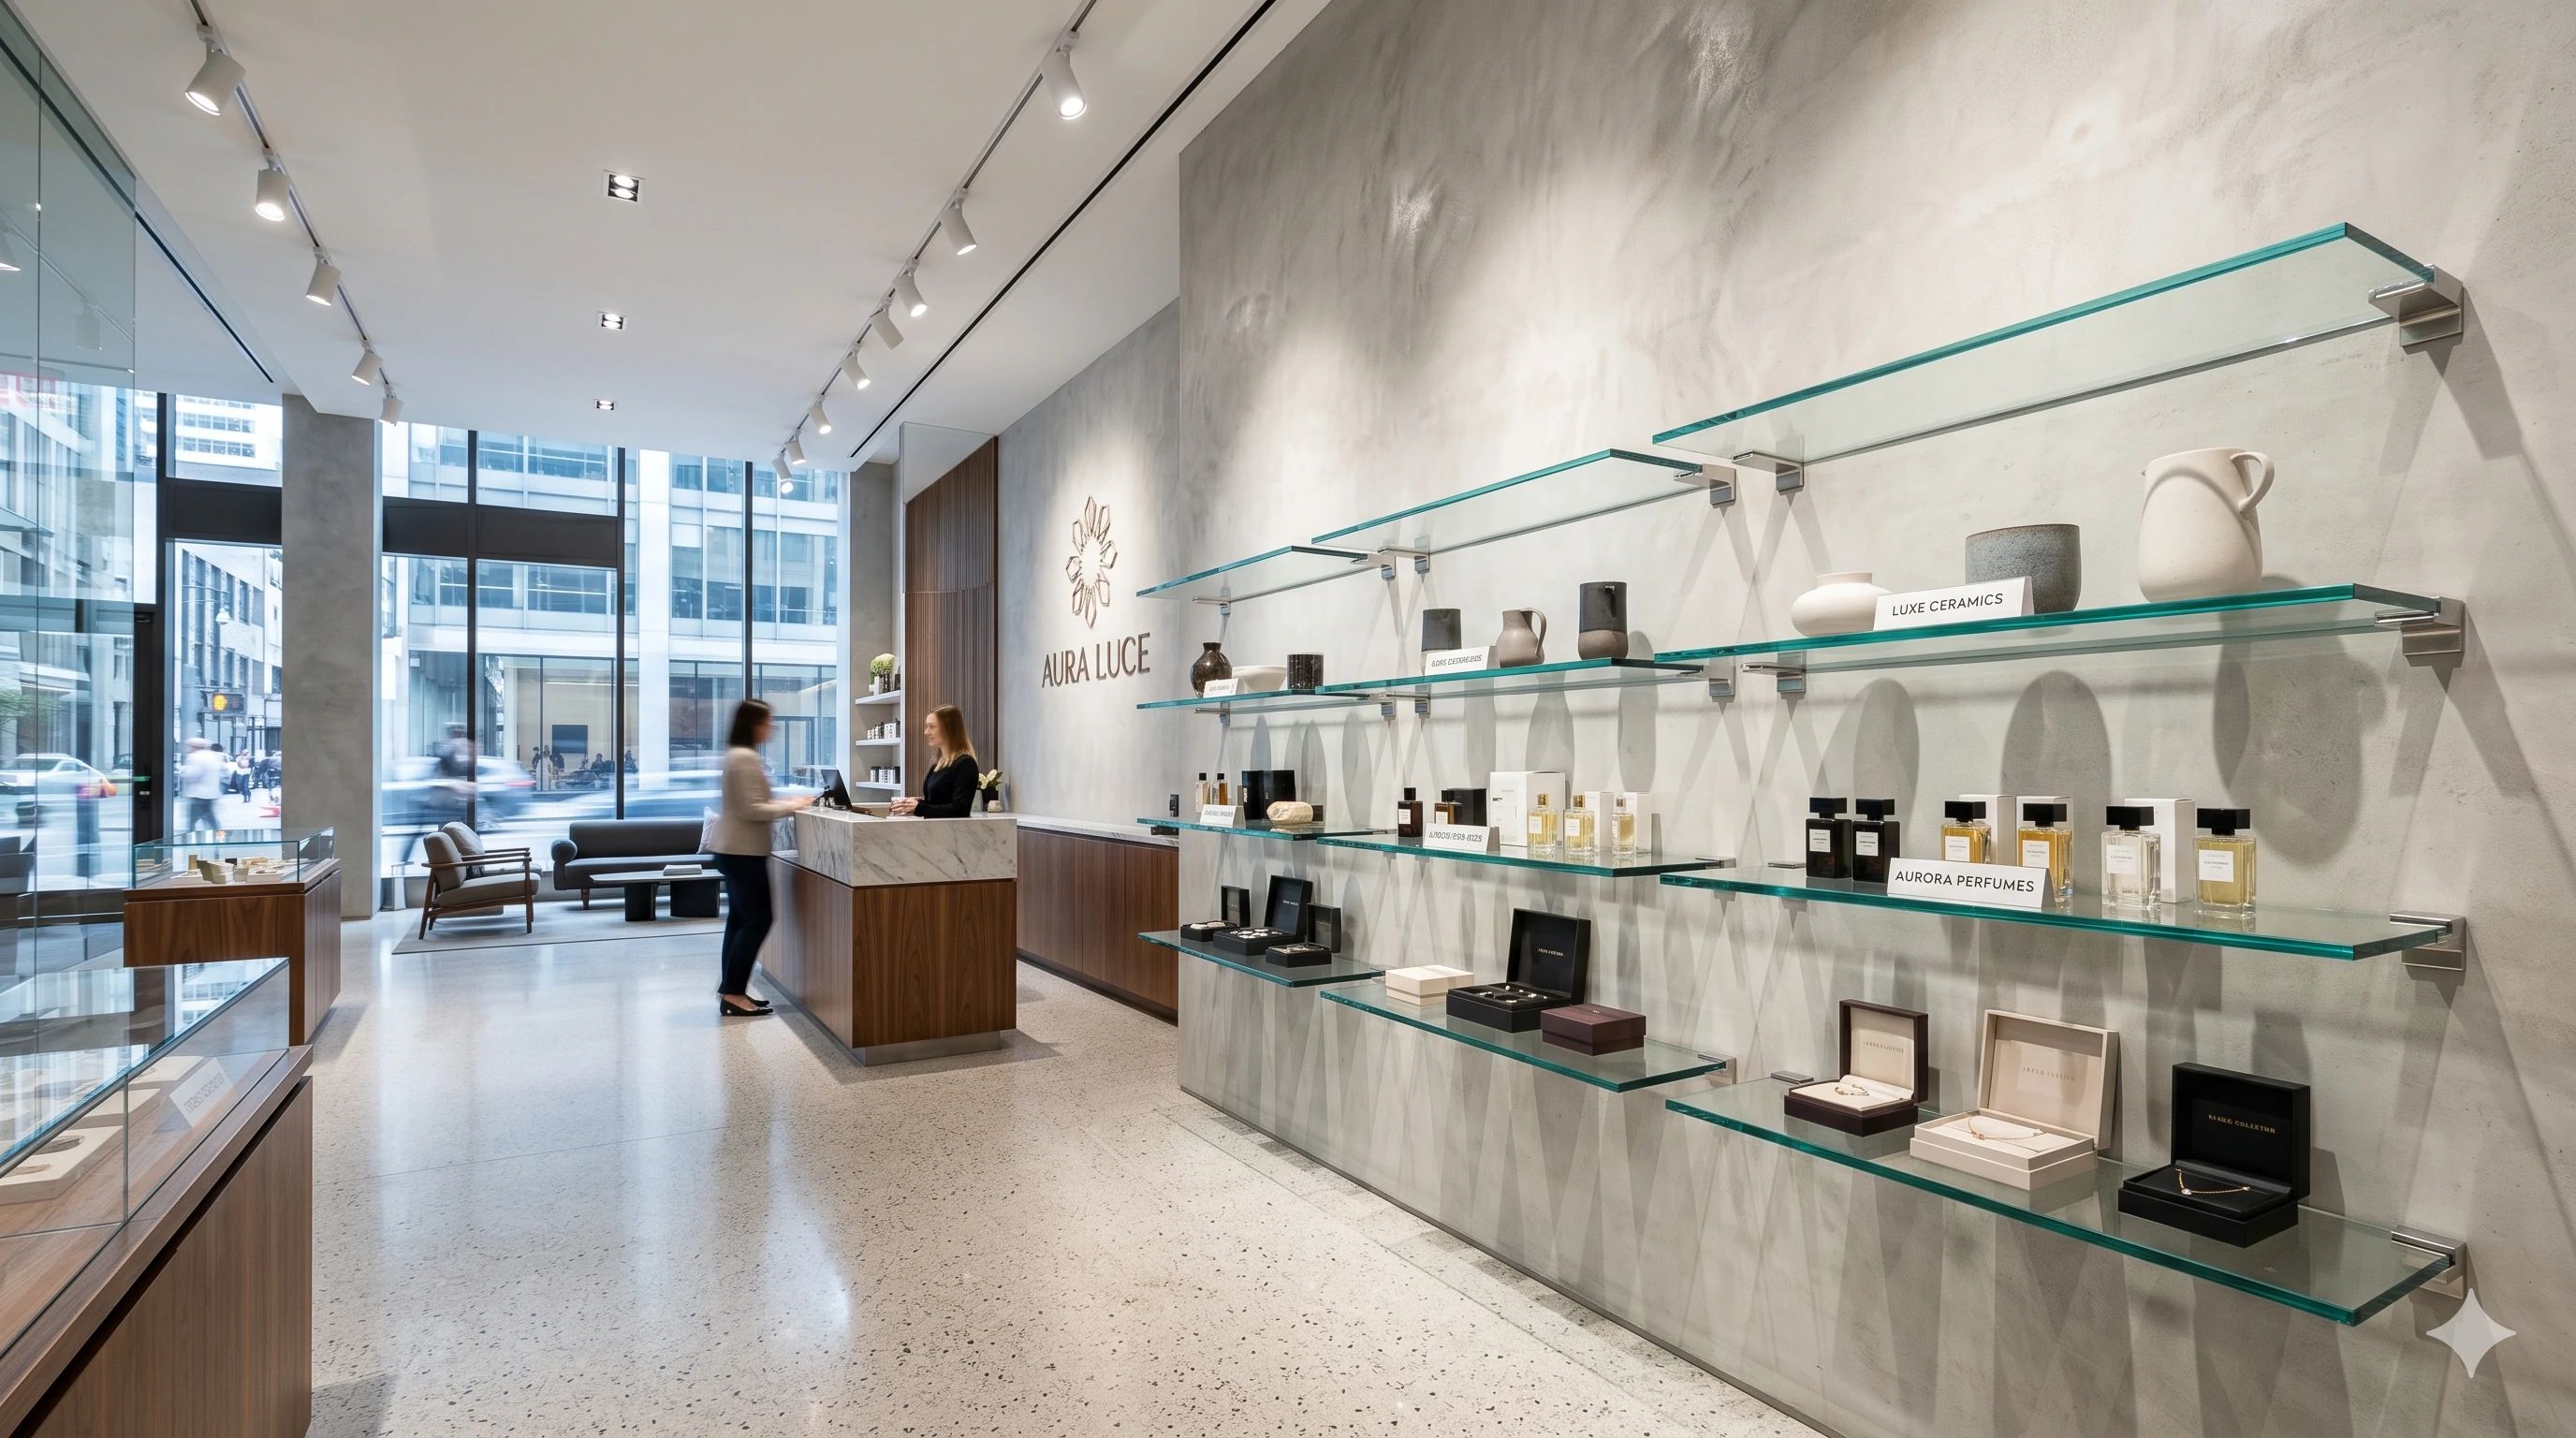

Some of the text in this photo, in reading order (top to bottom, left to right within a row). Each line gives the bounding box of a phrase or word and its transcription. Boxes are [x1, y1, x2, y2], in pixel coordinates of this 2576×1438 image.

[1892, 593, 2003, 616] LUXE CERAMICS
[1041, 632, 1150, 688] AURA LUCE
[1895, 871, 2035, 892] AURORA PERFUMES
